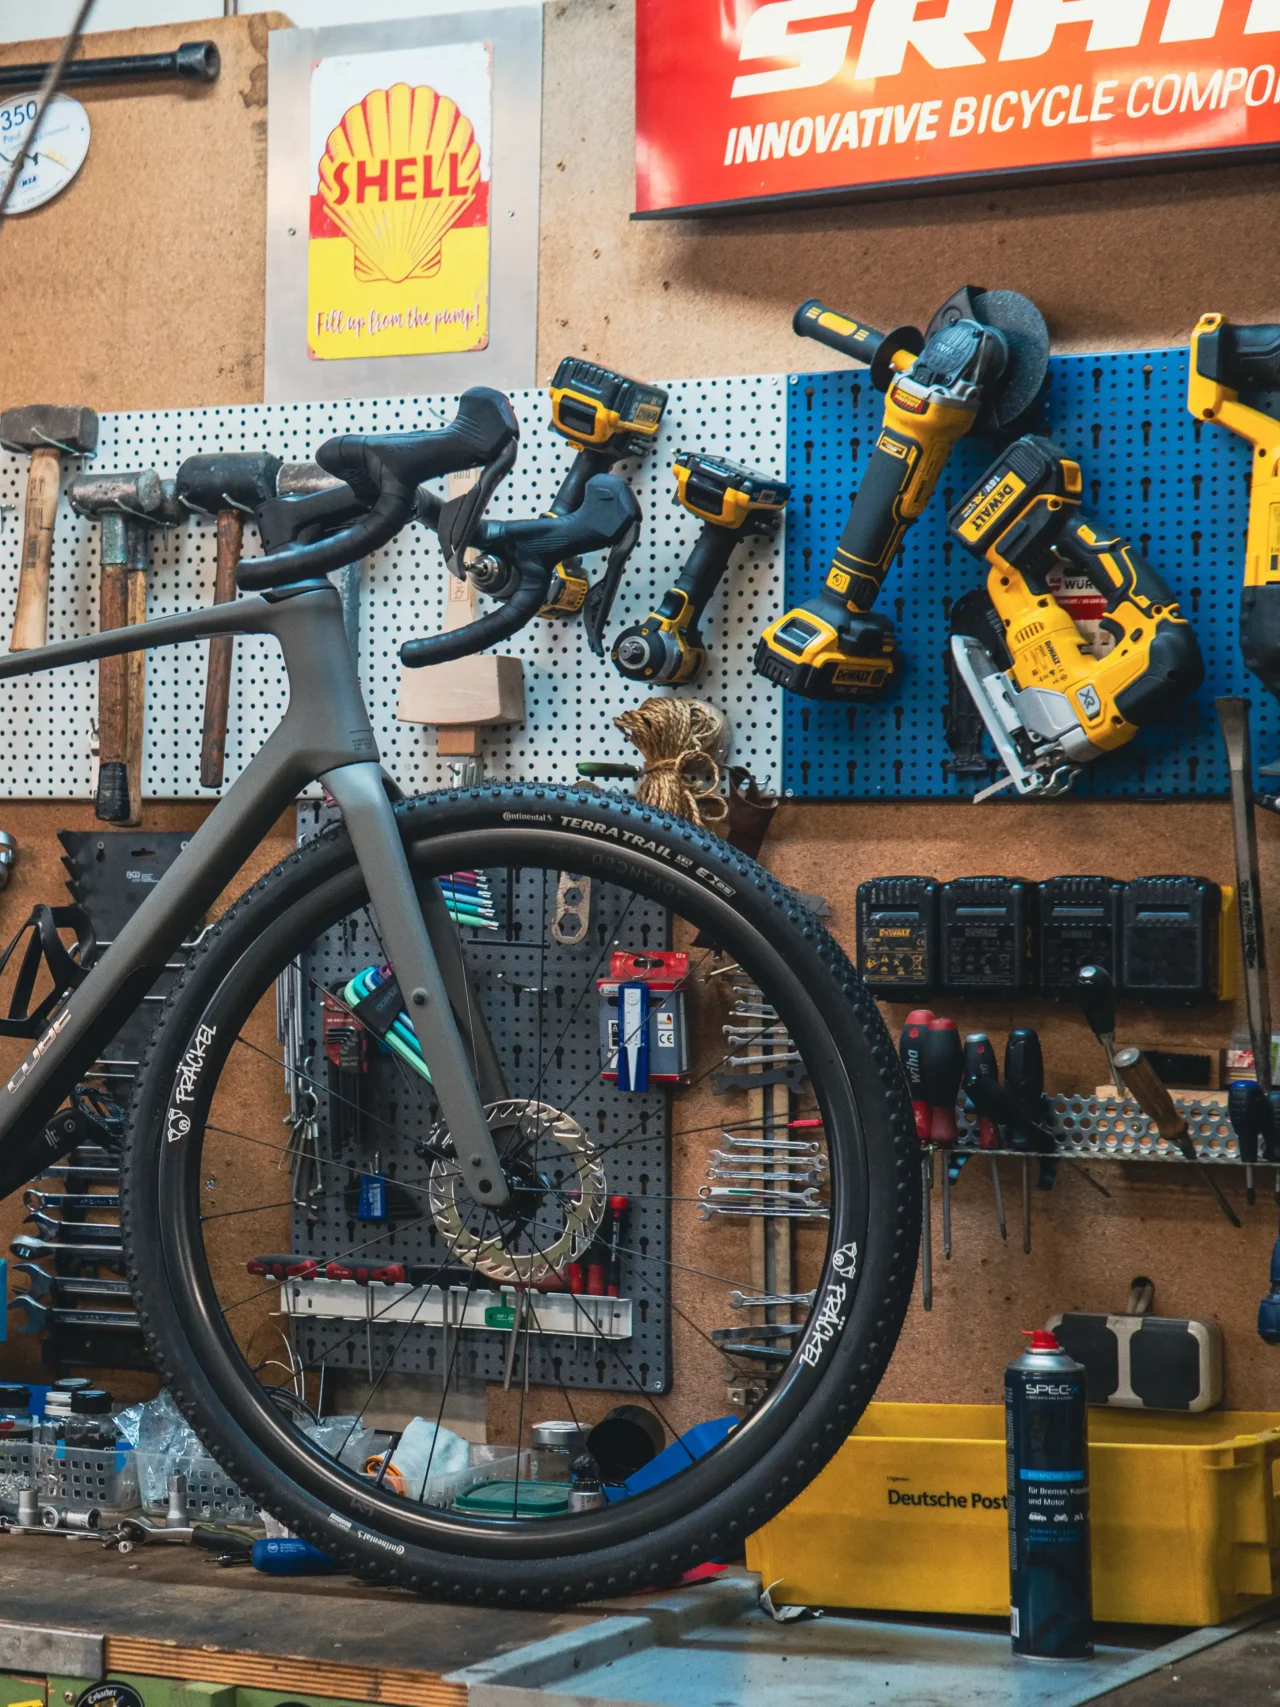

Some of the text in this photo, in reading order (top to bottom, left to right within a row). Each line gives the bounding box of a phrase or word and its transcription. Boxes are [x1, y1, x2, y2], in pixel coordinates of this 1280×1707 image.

[0, 100, 38, 131] 350
[724, 64, 1280, 166] INNOVATIVE BICYCLE COMPO
[333, 152, 472, 206] SHELL
[315, 301, 480, 338] Fill up from the pump!
[1064, 579, 1093, 590] WÜR
[503, 811, 546, 822] Continental
[561, 816, 619, 839] TERRA
[622, 830, 671, 860] TRAIL
[906, 1049, 921, 1083] wiha
[888, 1489, 1008, 1510] Deutsche Post
[1028, 1486, 1038, 1495] für
[1039, 1486, 1069, 1497] Bremse,
[1028, 1497, 1065, 1507] und Motor
[363, 1532, 405, 1555] Continental
